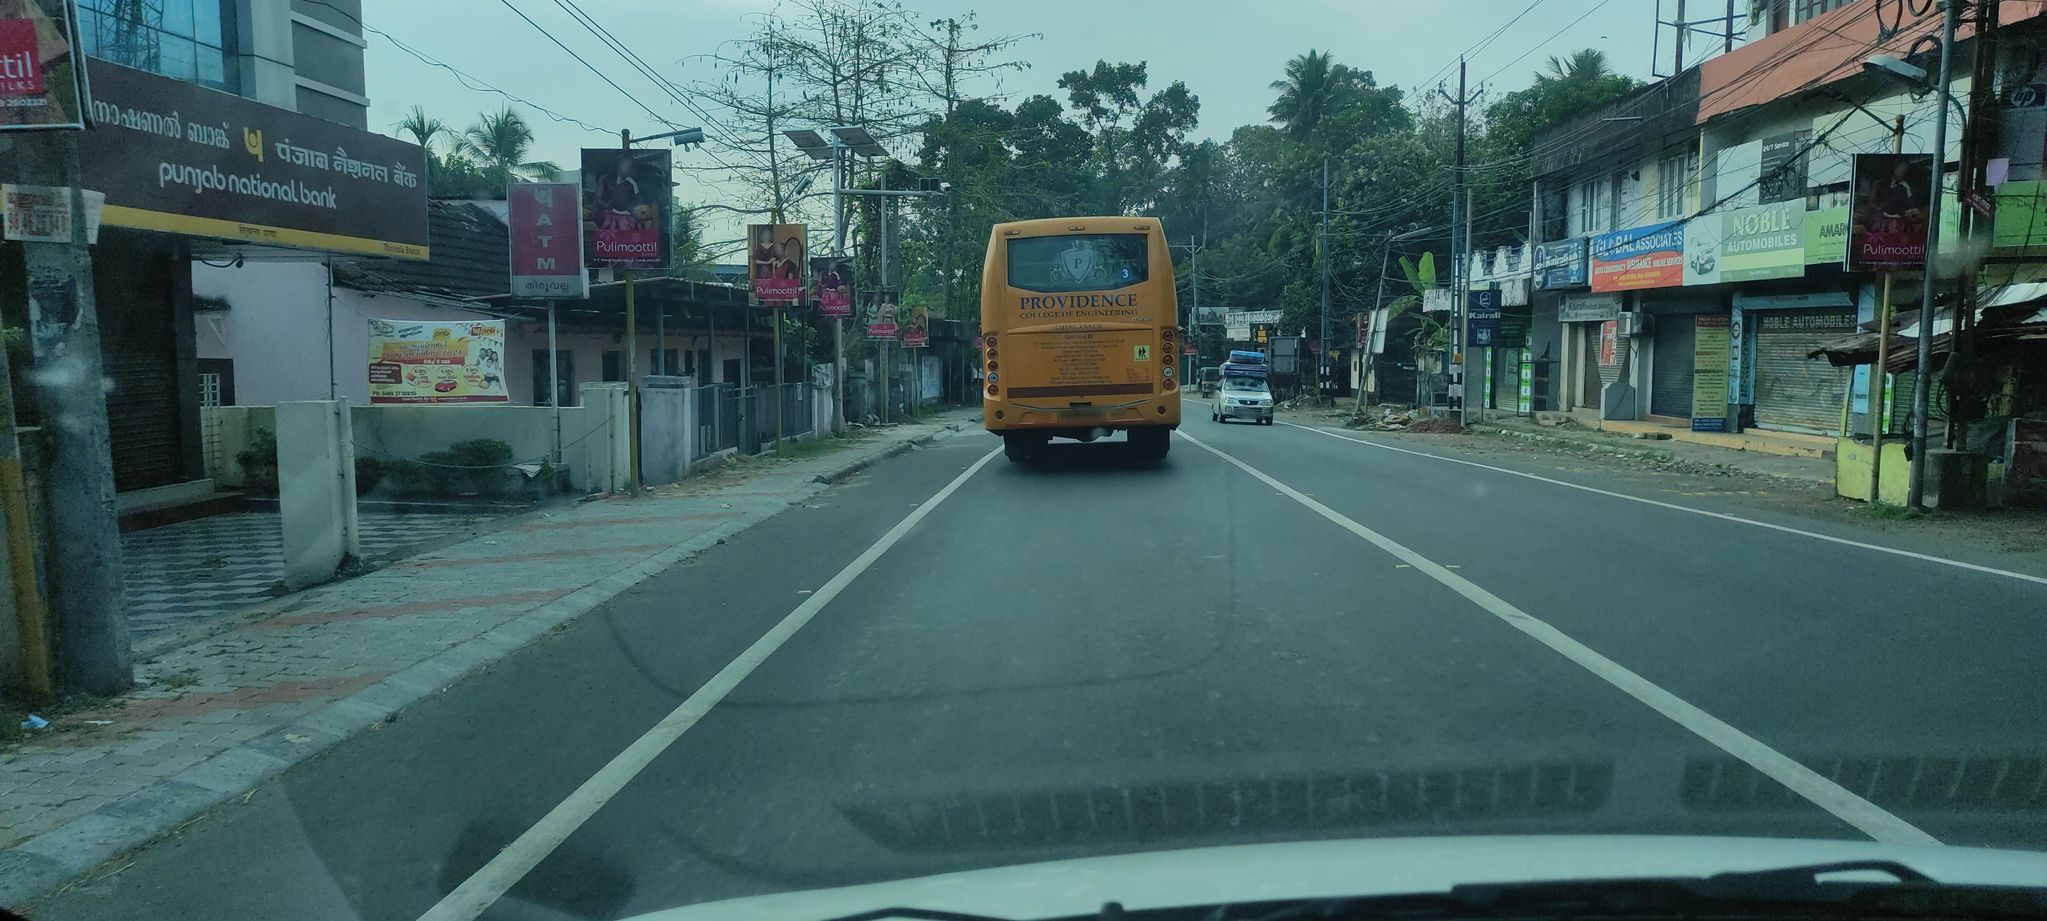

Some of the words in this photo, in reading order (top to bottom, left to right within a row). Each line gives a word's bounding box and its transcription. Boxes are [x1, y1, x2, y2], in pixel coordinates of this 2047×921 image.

[1774, 141, 1790, 150] Service
[274, 138, 329, 170] पंजाब
[159, 162, 226, 193] punjab
[229, 173, 299, 202] national
[300, 181, 336, 209] bank
[1733, 206, 1791, 236] NOBLE
[596, 241, 657, 252] Pulimoottil
[1635, 230, 1682, 250] ASSOCIATES
[1727, 233, 1797, 252] AUTOMOBILES
[1863, 243, 1924, 255] Pulimoottil
[1122, 269, 1129, 278] 3
[756, 286, 797, 296] Pulimoottil
[1020, 294, 1137, 310] PROVIDENCE
[1076, 309, 1138, 317] ENGINEERING
[1763, 317, 1790, 329] NOBLE
[1792, 314, 1857, 328] AUTOMOBILES
